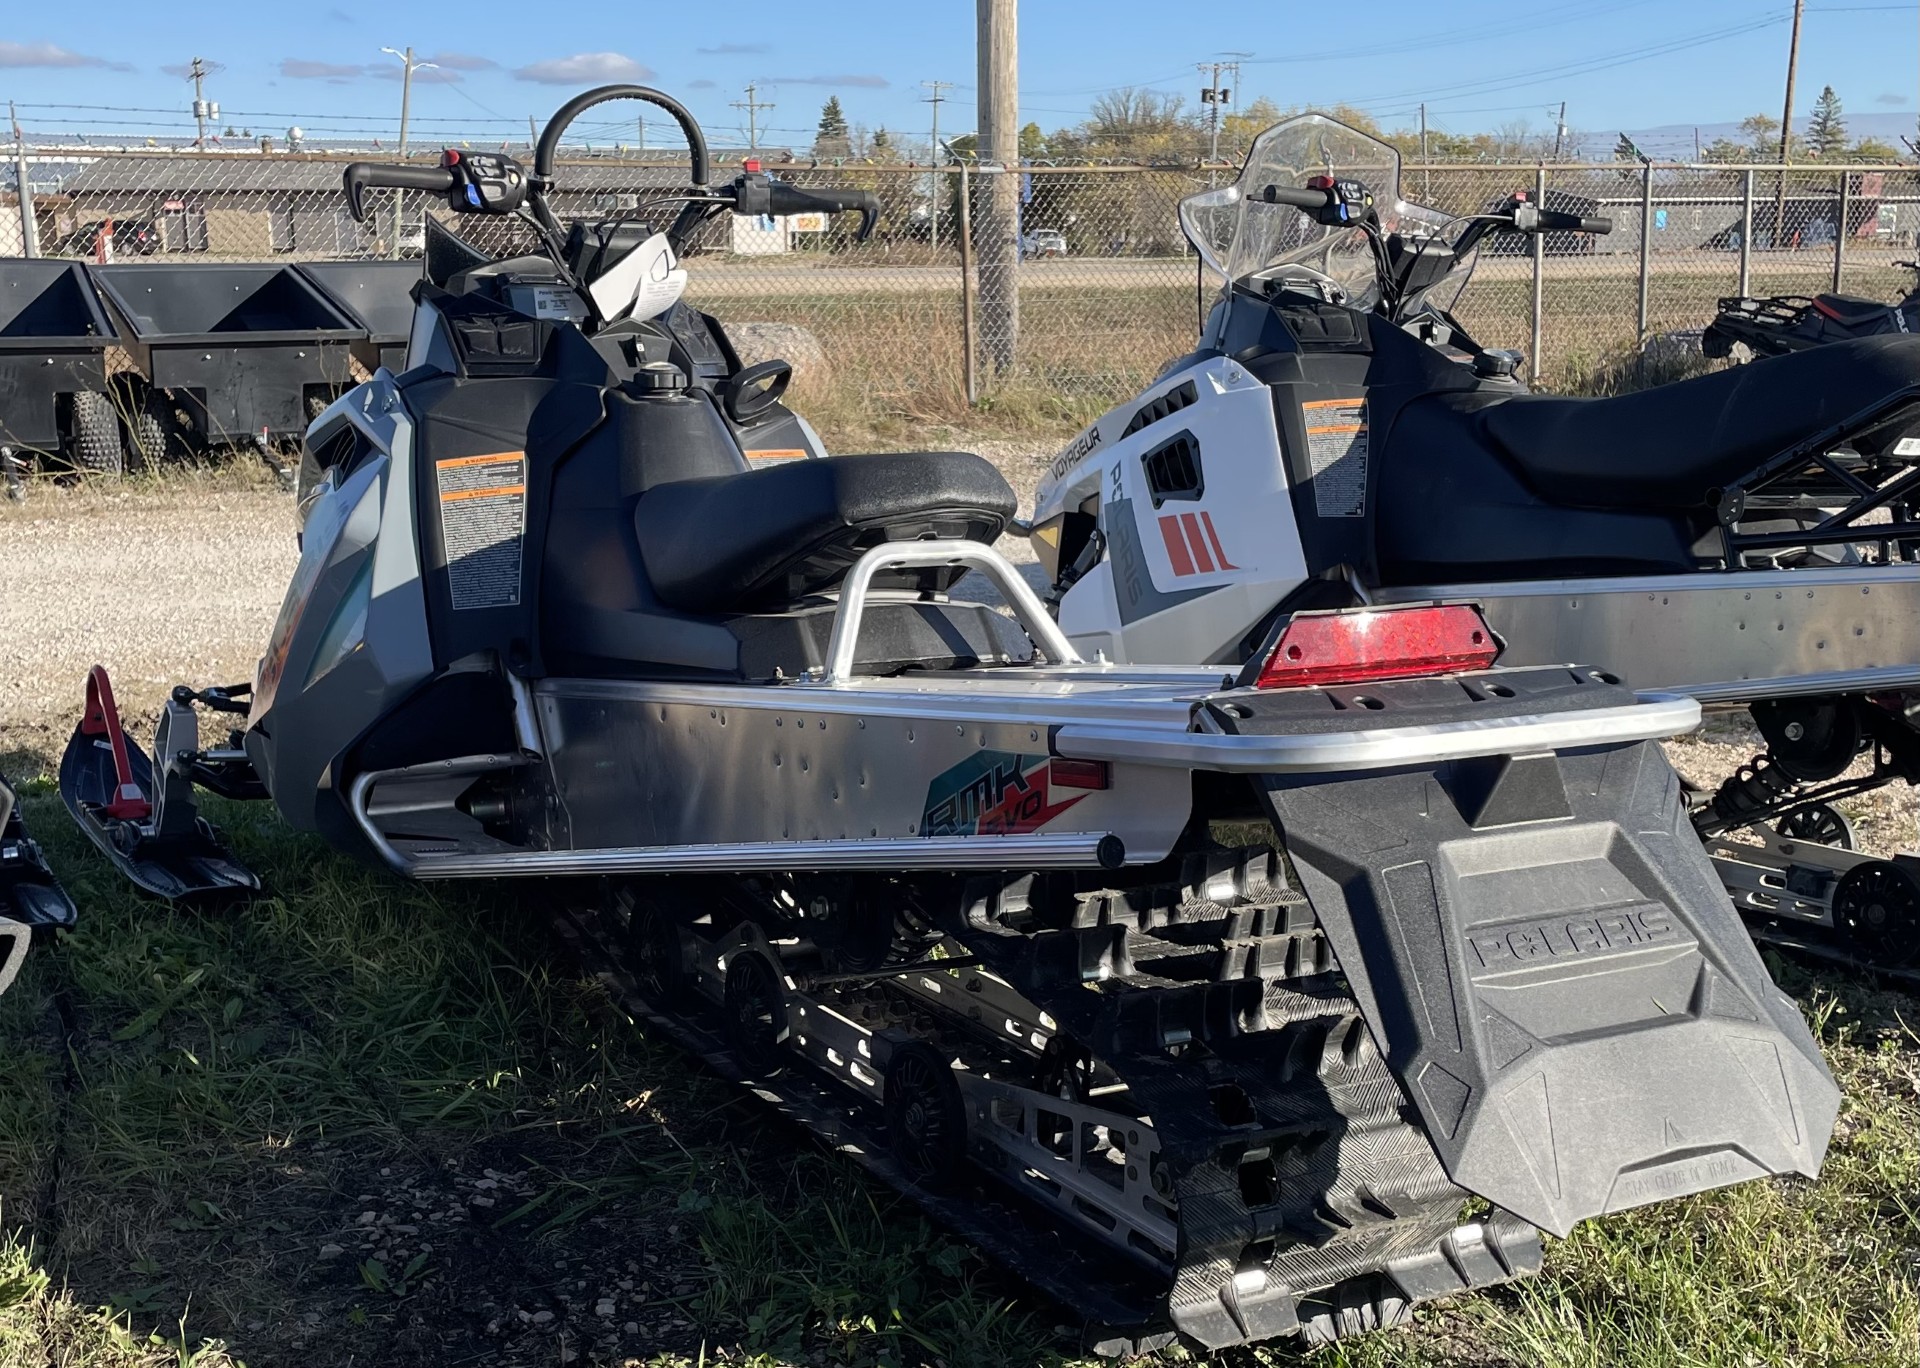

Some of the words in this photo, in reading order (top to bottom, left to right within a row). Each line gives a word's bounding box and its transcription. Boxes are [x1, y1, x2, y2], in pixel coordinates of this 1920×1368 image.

[1050, 425, 1102, 482] VOYAGEUR
[1109, 459, 1144, 607] POLARIS
[926, 753, 1031, 836] RMK
[985, 790, 1042, 834] EVO
[1467, 909, 1676, 968] POLARIS
